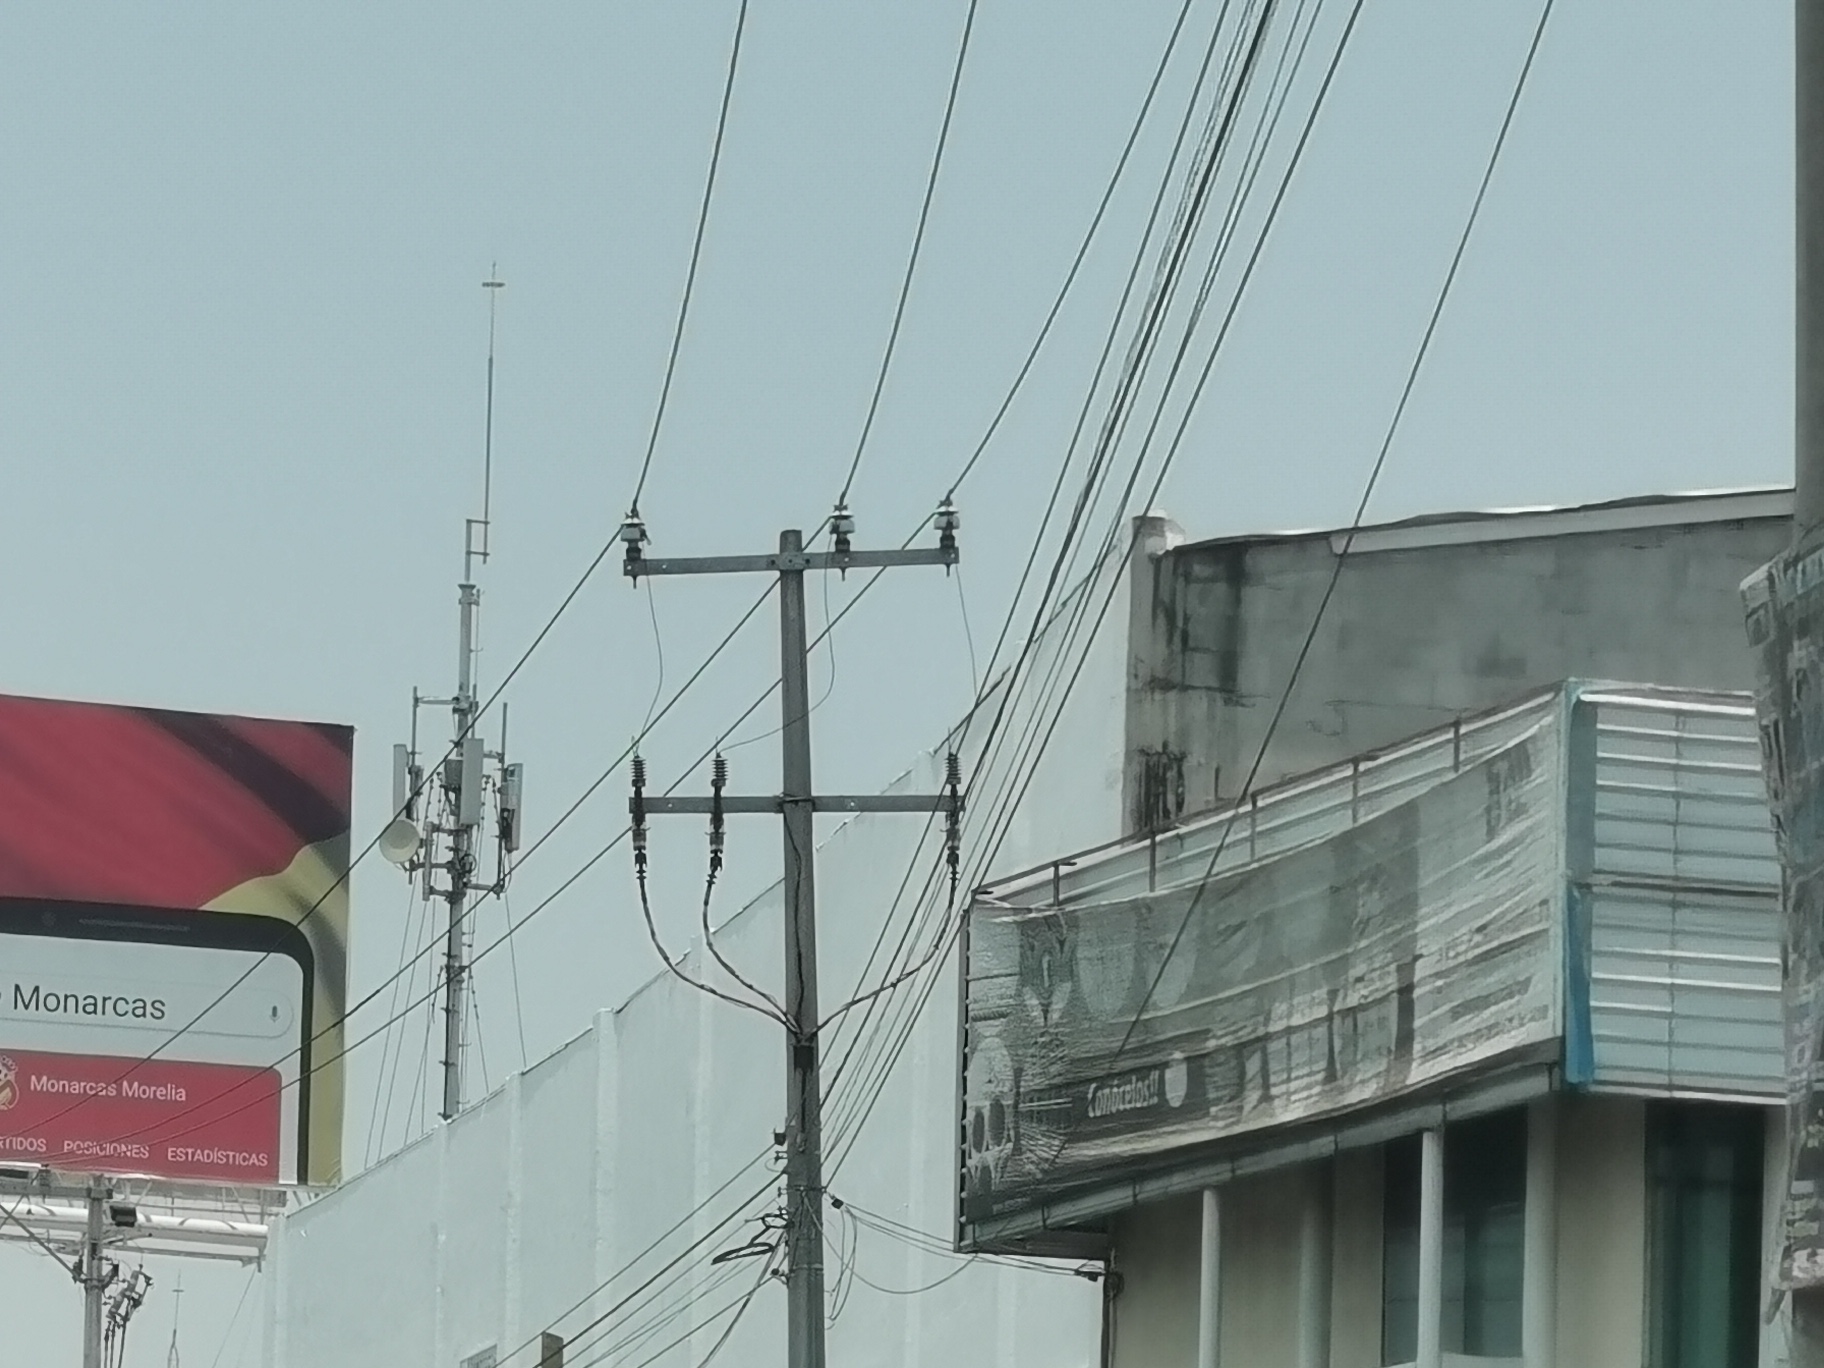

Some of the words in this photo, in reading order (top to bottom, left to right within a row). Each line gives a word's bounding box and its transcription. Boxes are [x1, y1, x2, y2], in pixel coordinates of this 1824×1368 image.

[13, 983, 166, 1020] Monarcas
[29, 1074, 117, 1097] Monarcas
[122, 1079, 187, 1102] Morelia
[63, 1140, 150, 1159] POSICIONES
[167, 1146, 269, 1167] ESTADÍSTICAS
